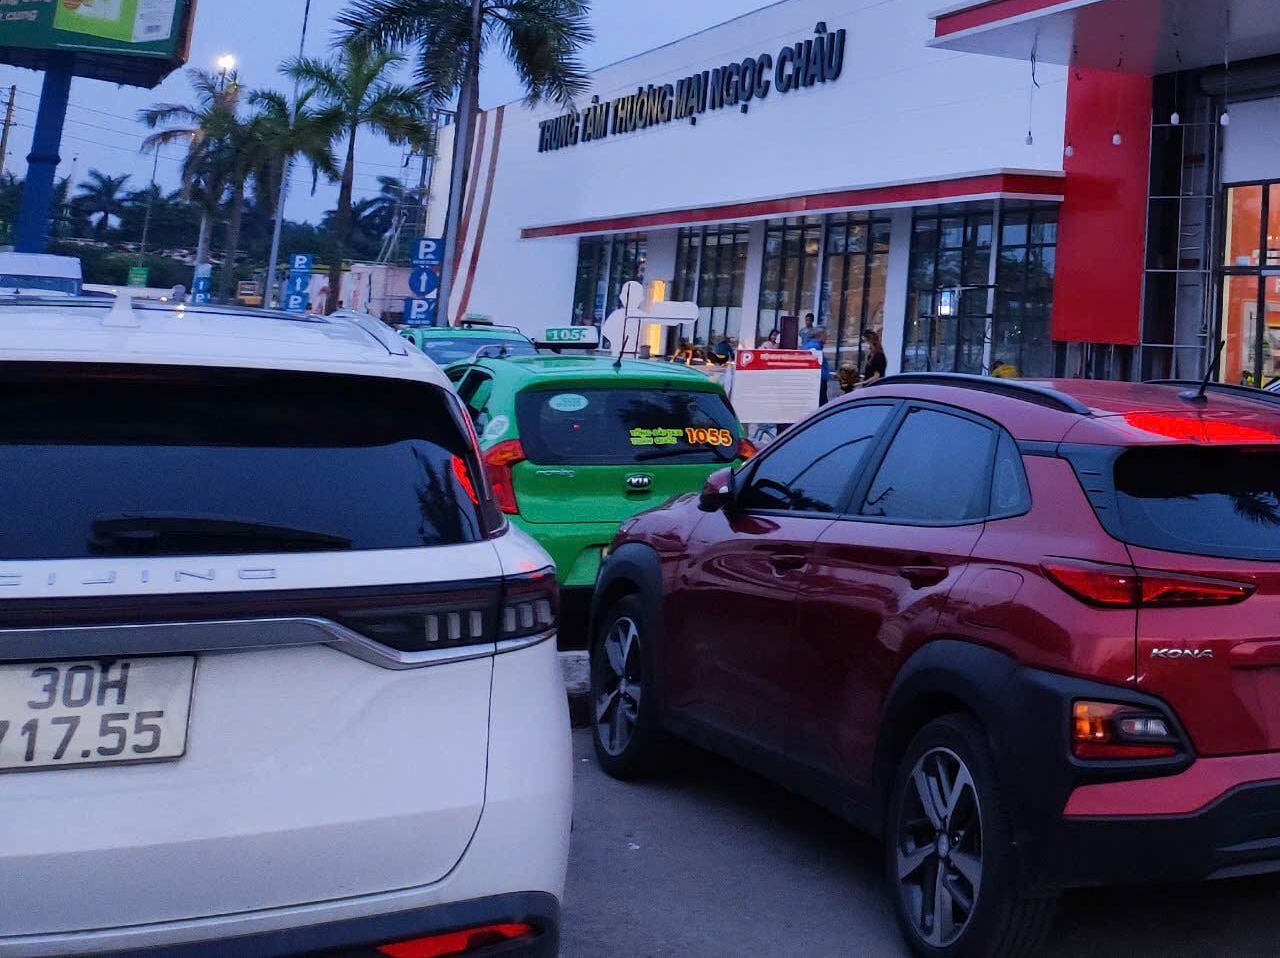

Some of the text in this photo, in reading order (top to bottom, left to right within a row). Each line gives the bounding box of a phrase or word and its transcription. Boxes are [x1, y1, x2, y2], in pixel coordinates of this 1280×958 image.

[538, 21, 847, 152] TRUNG TÂM THƯƠNG MẠI NGỌC CHÂU
[418, 240, 437, 259] P
[405, 299, 429, 319] P
[685, 427, 732, 446] 1055
[1150, 648, 1213, 658] KONA
[27, 663, 130, 709] 30H
